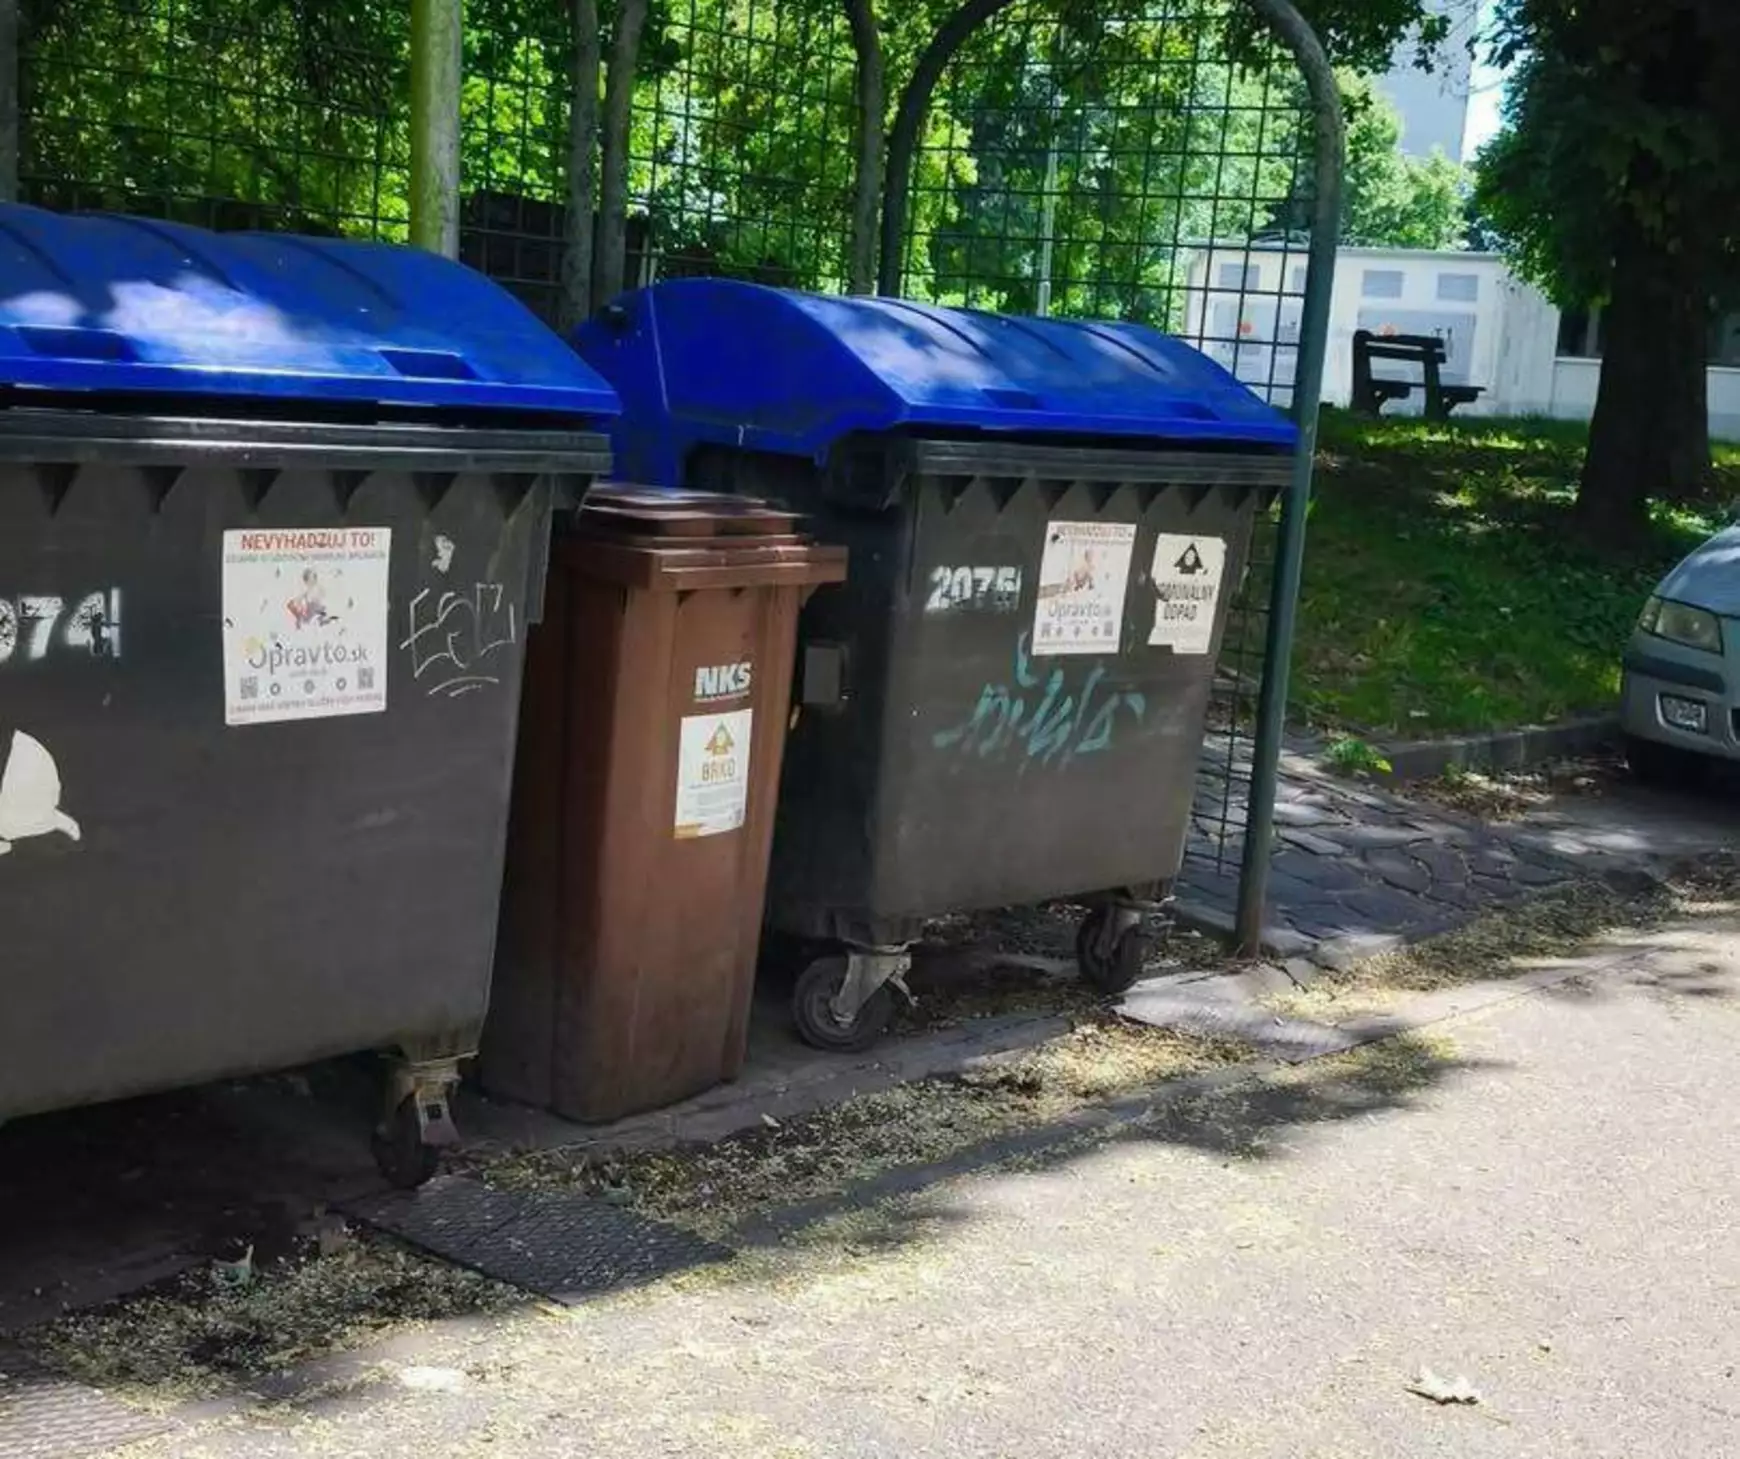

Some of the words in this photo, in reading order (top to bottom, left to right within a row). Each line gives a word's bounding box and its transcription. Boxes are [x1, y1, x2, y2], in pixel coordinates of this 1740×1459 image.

[241, 533, 345, 550] NEVYHADZUJ
[351, 532, 375, 547] TO!
[695, 662, 751, 696] NKS
